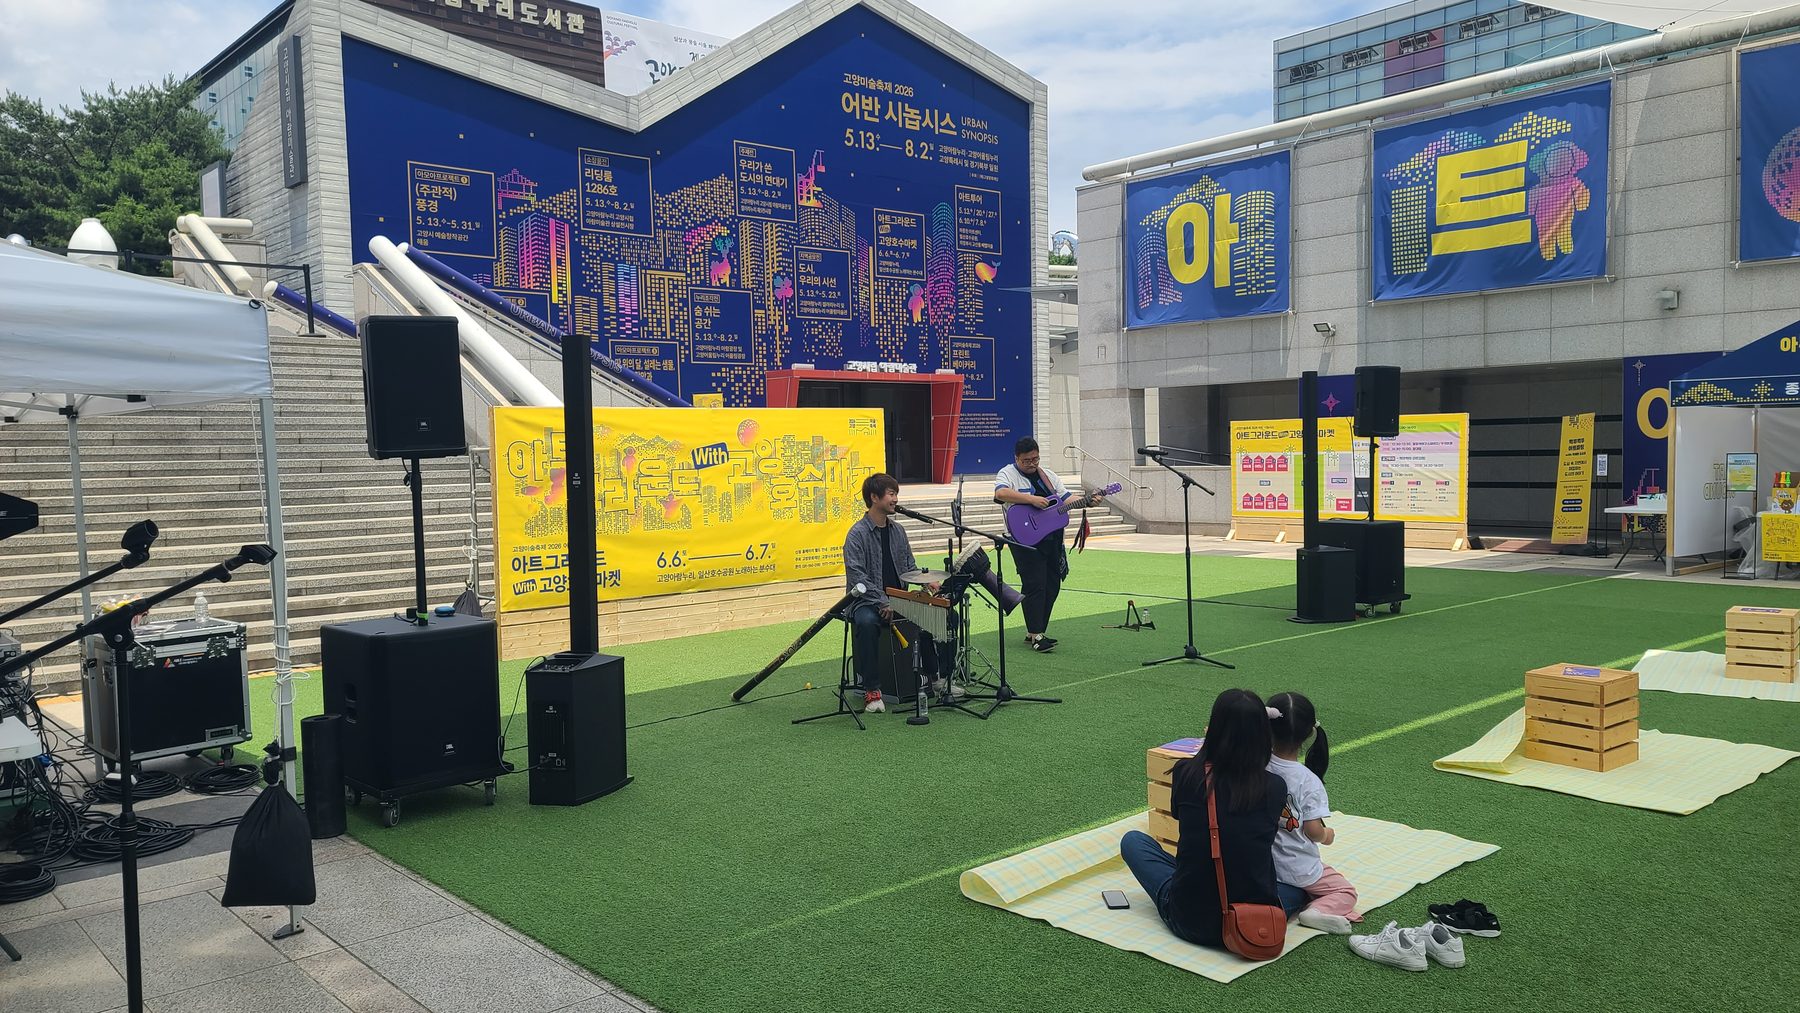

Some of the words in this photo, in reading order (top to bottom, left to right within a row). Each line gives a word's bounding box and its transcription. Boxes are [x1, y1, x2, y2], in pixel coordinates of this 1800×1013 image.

[843, 73, 892, 94] 고양미술축제
[894, 84, 914, 98] 2026
[842, 92, 880, 122] 어반
[884, 100, 958, 135] 시놉시스
[961, 116, 988, 130] URBAN
[961, 130, 999, 145] SYNOPSIS
[739, 159, 763, 173] 우리가
[764, 163, 772, 174] 쓴
[585, 168, 613, 182] 리딩룸
[740, 172, 764, 185] 도시의
[765, 175, 788, 188] 연대기
[415, 182, 457, 201] (주관적)
[585, 182, 618, 196] 1286호
[959, 192, 982, 204] 아트투어
[1431, 140, 1531, 256] 트
[416, 198, 438, 213] 풍경
[878, 214, 917, 227] 아트그라운드
[416, 230, 434, 239] 고양시
[435, 232, 468, 241] 예술창작공간
[879, 236, 917, 249] 고양호수마켓
[1166, 193, 1239, 288] 아
[799, 276, 820, 286] 우리의
[822, 277, 836, 288] 시선
[694, 306, 702, 316] 숨
[704, 306, 720, 317] 쉬는
[510, 304, 557, 336] URBAN
[695, 318, 711, 329] 공간
[952, 350, 970, 358] 프린트
[622, 359, 634, 370] 위의
[644, 359, 661, 370] 설레는
[847, 360, 877, 372] 고양시립
[879, 362, 917, 373] 아람미술관
[953, 360, 976, 369] 베이커리
[1236, 431, 1278, 440] 아트그라운드
[694, 446, 728, 467] With
[512, 544, 546, 553] 고양미술축제
[698, 568, 734, 579] 일산호수공원
[735, 566, 758, 575] 노래하는
[759, 564, 776, 572] 분수대
[514, 580, 536, 595] With
